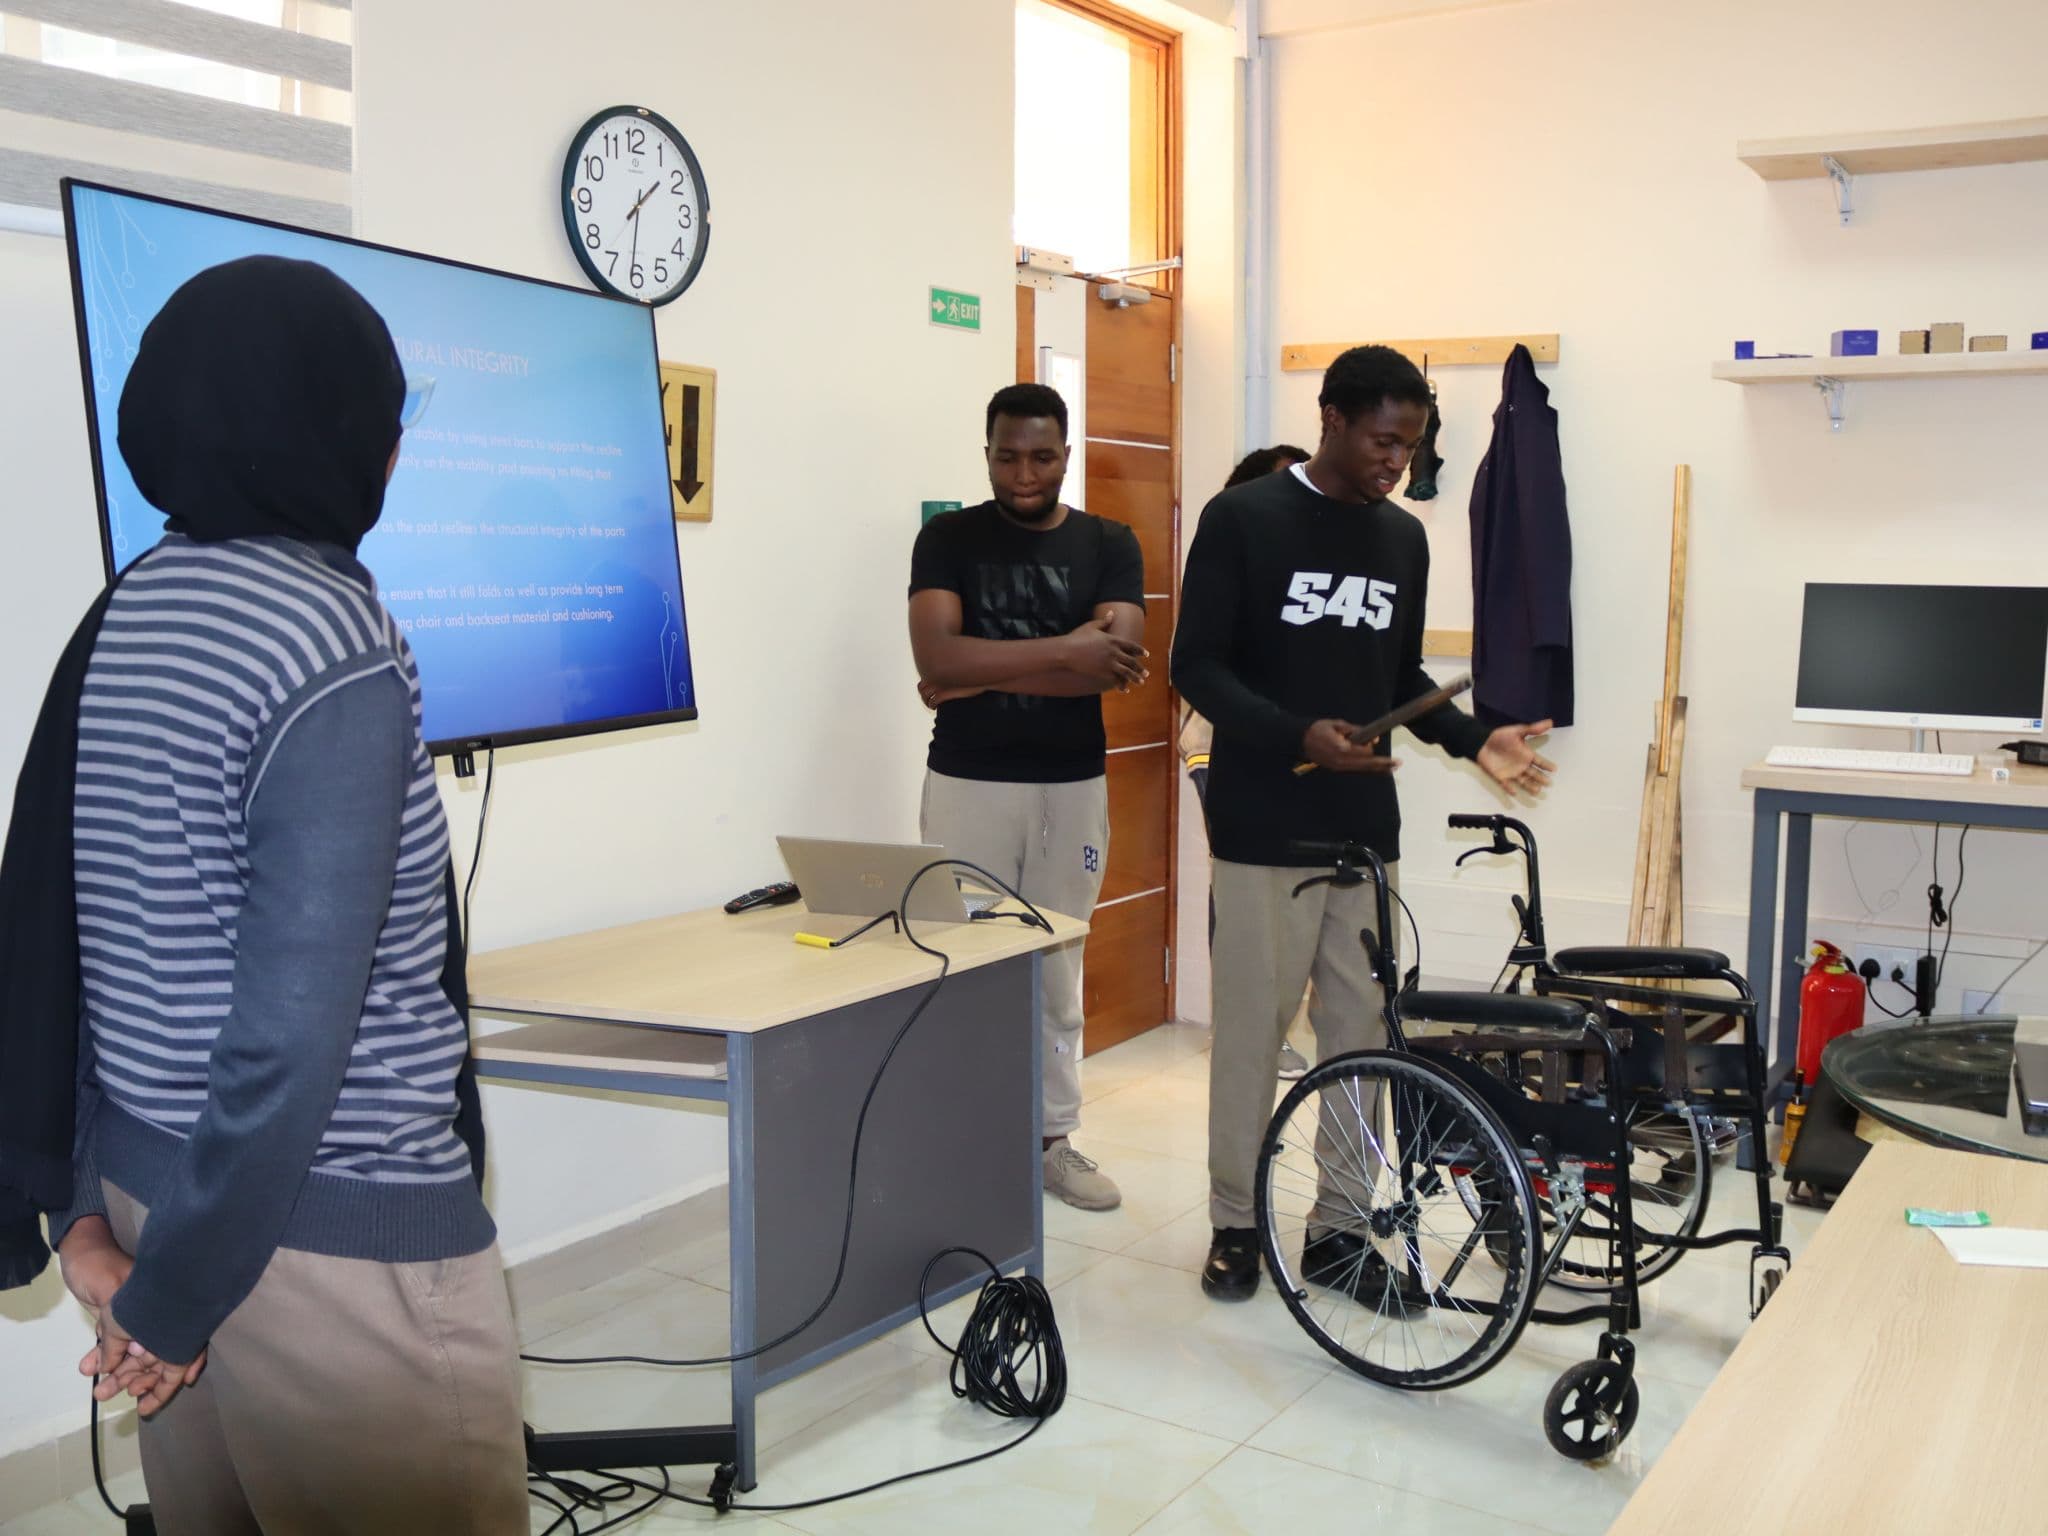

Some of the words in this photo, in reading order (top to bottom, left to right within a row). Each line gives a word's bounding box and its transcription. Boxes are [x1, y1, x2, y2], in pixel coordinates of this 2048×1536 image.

[604, 131, 619, 159] 11
[626, 127, 645, 155] 12
[657, 142, 663, 167] 1
[584, 155, 604, 182] 10
[670, 170, 684, 195] 2
[577, 187, 592, 213] 9
[678, 204, 691, 229] 3
[586, 223, 600, 249] 8
[671, 237, 685, 261] 4
[605, 250, 619, 276] 7
[654, 258, 668, 283] 5
[630, 263, 644, 289] 6
[961, 303, 978, 320] EXIT
[450, 345, 528, 377] INTEGRITY
[396, 519, 413, 534] the
[416, 520, 438, 536] pad
[480, 520, 496, 534] the
[539, 521, 576, 540] integrity
[578, 522, 588, 536] of
[590, 524, 602, 536] the
[605, 527, 625, 539] parts
[391, 590, 424, 601] ensure
[427, 583, 448, 599] that
[450, 583, 457, 598] it
[460, 583, 476, 599] still
[479, 583, 502, 598] folds
[504, 586, 514, 597] as
[518, 582, 535, 597] well
[538, 585, 548, 596] as
[551, 582, 583, 599] provide
[585, 581, 602, 598] long
[604, 583, 624, 594] term
[416, 613, 441, 629] chair
[445, 611, 464, 627] and
[512, 609, 549, 624] material
[552, 607, 568, 622] and
[571, 606, 614, 624] cushioning.
